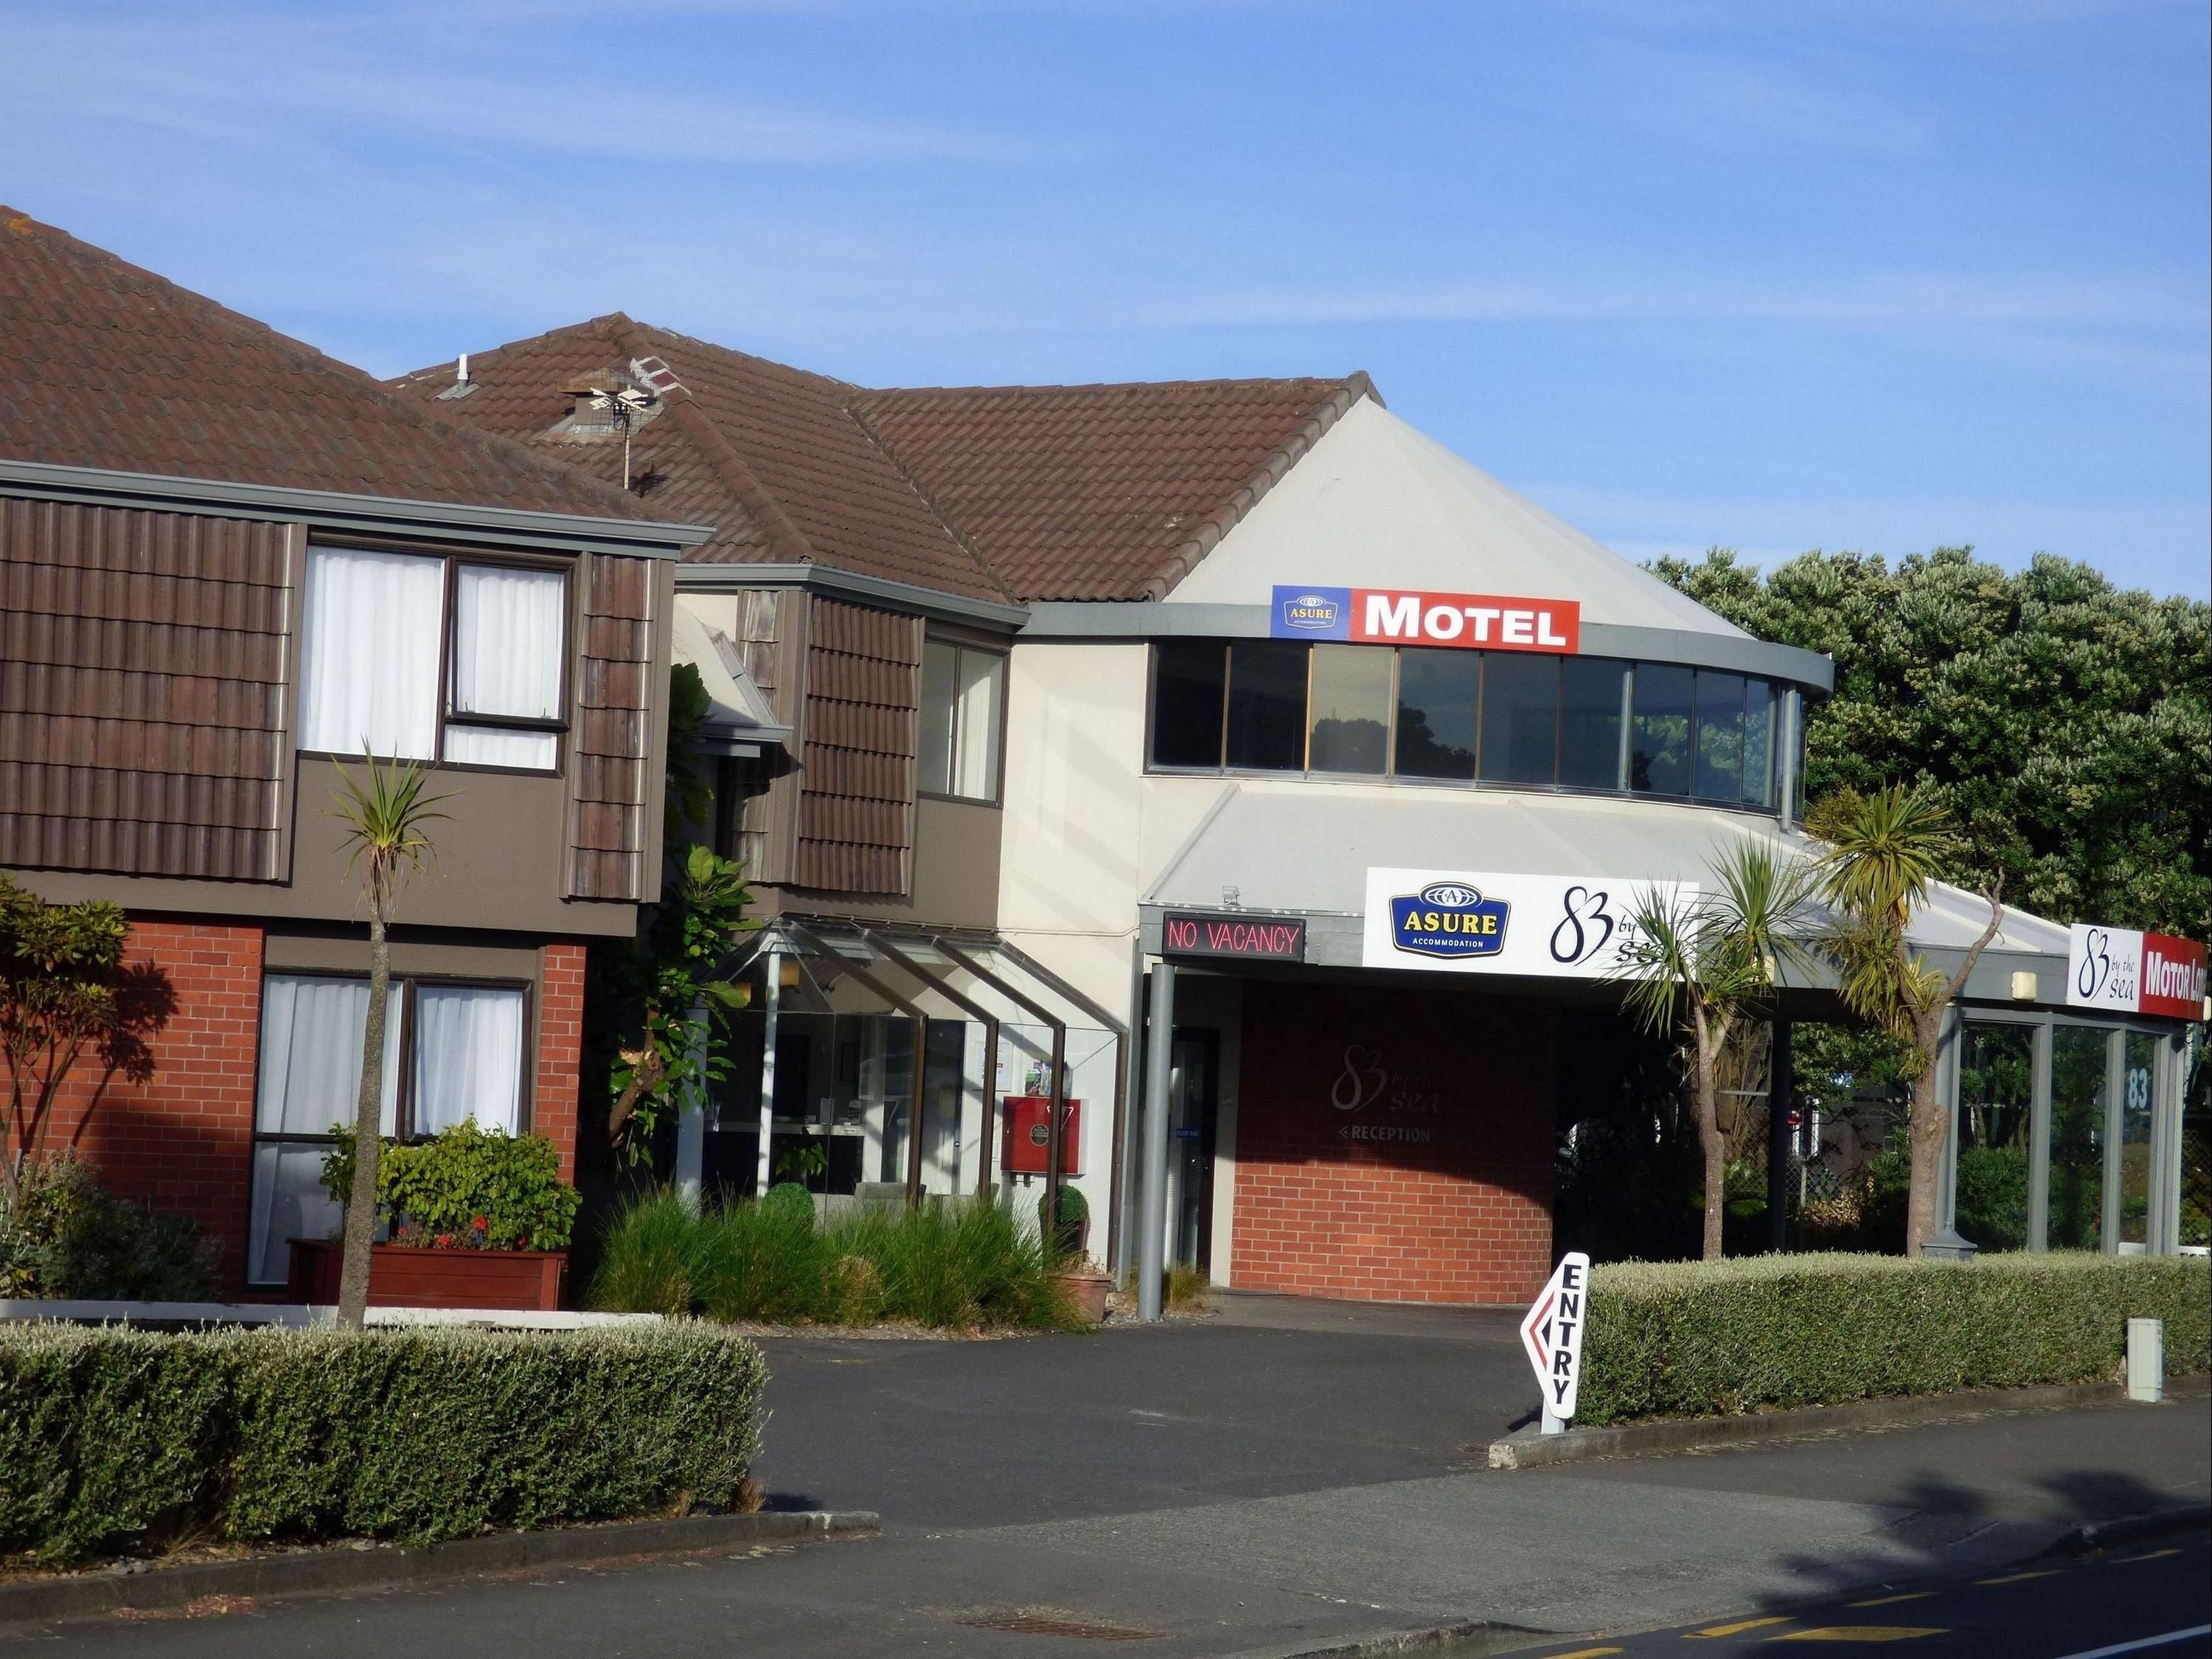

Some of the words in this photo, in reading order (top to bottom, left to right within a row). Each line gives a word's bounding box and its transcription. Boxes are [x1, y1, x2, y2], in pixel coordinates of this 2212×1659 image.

[1290, 608, 1333, 619] ASURE
[1364, 594, 1566, 647] MOTEL
[1167, 920, 1198, 948] NO
[1207, 922, 1300, 954] VACANCY
[1403, 911, 1498, 936] ASURE
[1549, 885, 1614, 967] 83
[1618, 914, 1637, 940] by
[1412, 936, 1484, 948] ACCOMMODATION
[2078, 928, 2110, 1002] 83
[2111, 954, 2121, 976] by
[2123, 954, 2135, 973] the
[2145, 950, 2191, 1000] MOTOR
[2109, 977, 2135, 1001] sea
[1331, 1043, 1388, 1113] 83
[2128, 1068, 2148, 1110] 83
[1388, 1091, 1439, 1114] sea
[1352, 1124, 1430, 1142] RECEPTION
[1553, 1263, 1582, 1405] ENTRY
